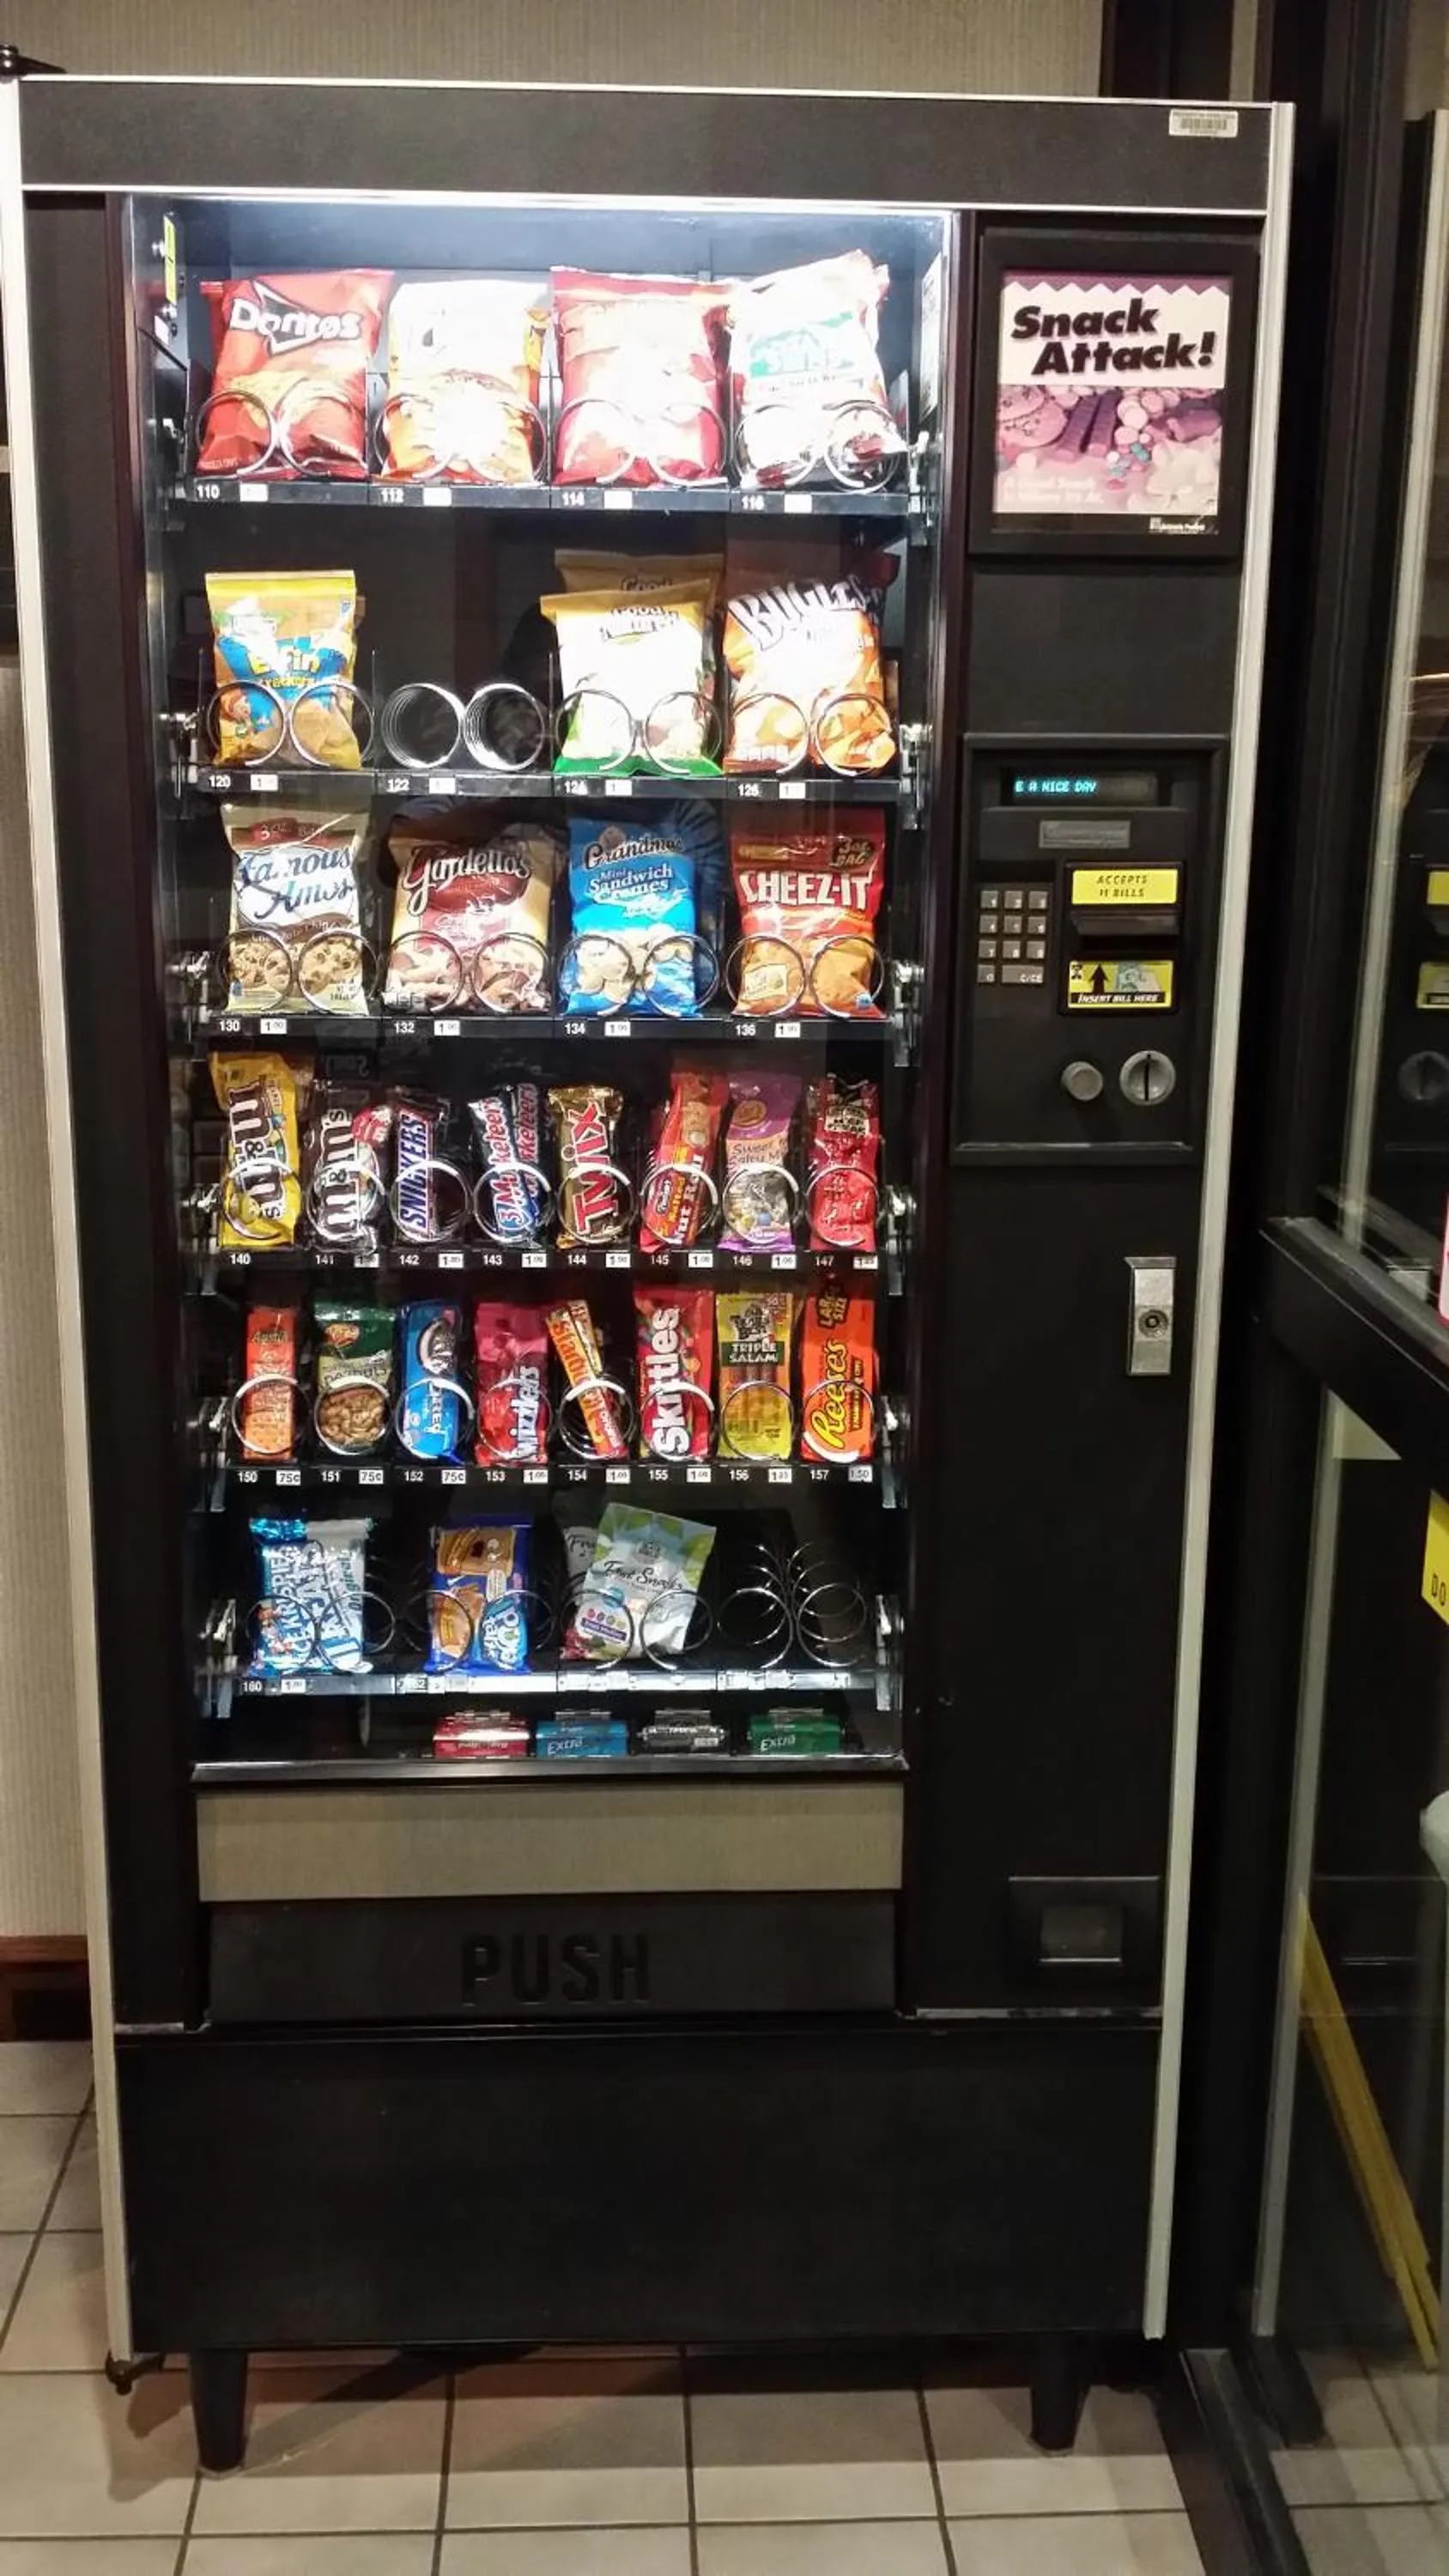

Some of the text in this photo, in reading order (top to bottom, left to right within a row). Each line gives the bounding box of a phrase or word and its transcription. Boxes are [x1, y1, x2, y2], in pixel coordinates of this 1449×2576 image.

[229, 297, 361, 340] Doritos
[1010, 297, 1160, 340] Snack
[1030, 330, 1216, 375] Attack!
[197, 485, 220, 499] 110
[380, 489, 403, 503] 112
[209, 775, 232, 787] 120
[387, 779, 409, 793] 122
[1028, 781, 1037, 793] A
[1041, 781, 1070, 793] NICE
[1075, 781, 1097, 793] DAY
[589, 863, 674, 893] Sandwich
[1096, 874, 1148, 884] ACCEPTS
[739, 870, 874, 910] CHEEZ-IT
[1113, 888, 1144, 897] BILLS
[1077, 993, 1111, 1003] INSERT
[1134, 993, 1159, 1003] HERE
[219, 1019, 240, 1032] 130
[393, 1022, 415, 1034] 132
[564, 1023, 585, 1036] 134
[735, 1024, 756, 1036] 136
[483, 1096, 521, 1206] Muketeers
[230, 1255, 251, 1265] 140
[315, 1255, 335, 1265] 141
[399, 1255, 420, 1266] 142
[482, 1255, 502, 1266] 143
[567, 1255, 586, 1265] 144
[650, 1255, 670, 1265] 145
[815, 1256, 834, 1267] 147
[731, 1340, 777, 1352] TRIPLE
[646, 1307, 690, 1454] Skittles
[811, 1338, 849, 1449] Reese's
[238, 1472, 258, 1483] 150
[321, 1471, 340, 1482] 151
[404, 1471, 423, 1481] 152
[486, 1471, 506, 1482] 153
[567, 1470, 587, 1480] 154
[649, 1470, 669, 1480] 155
[729, 1470, 749, 1480] 156
[810, 1469, 830, 1479] 157
[241, 1682, 263, 1692] 160
[547, 1737, 583, 1756] Extra
[761, 1734, 796, 1753] Extra
[460, 1934, 652, 2007] PUSH
